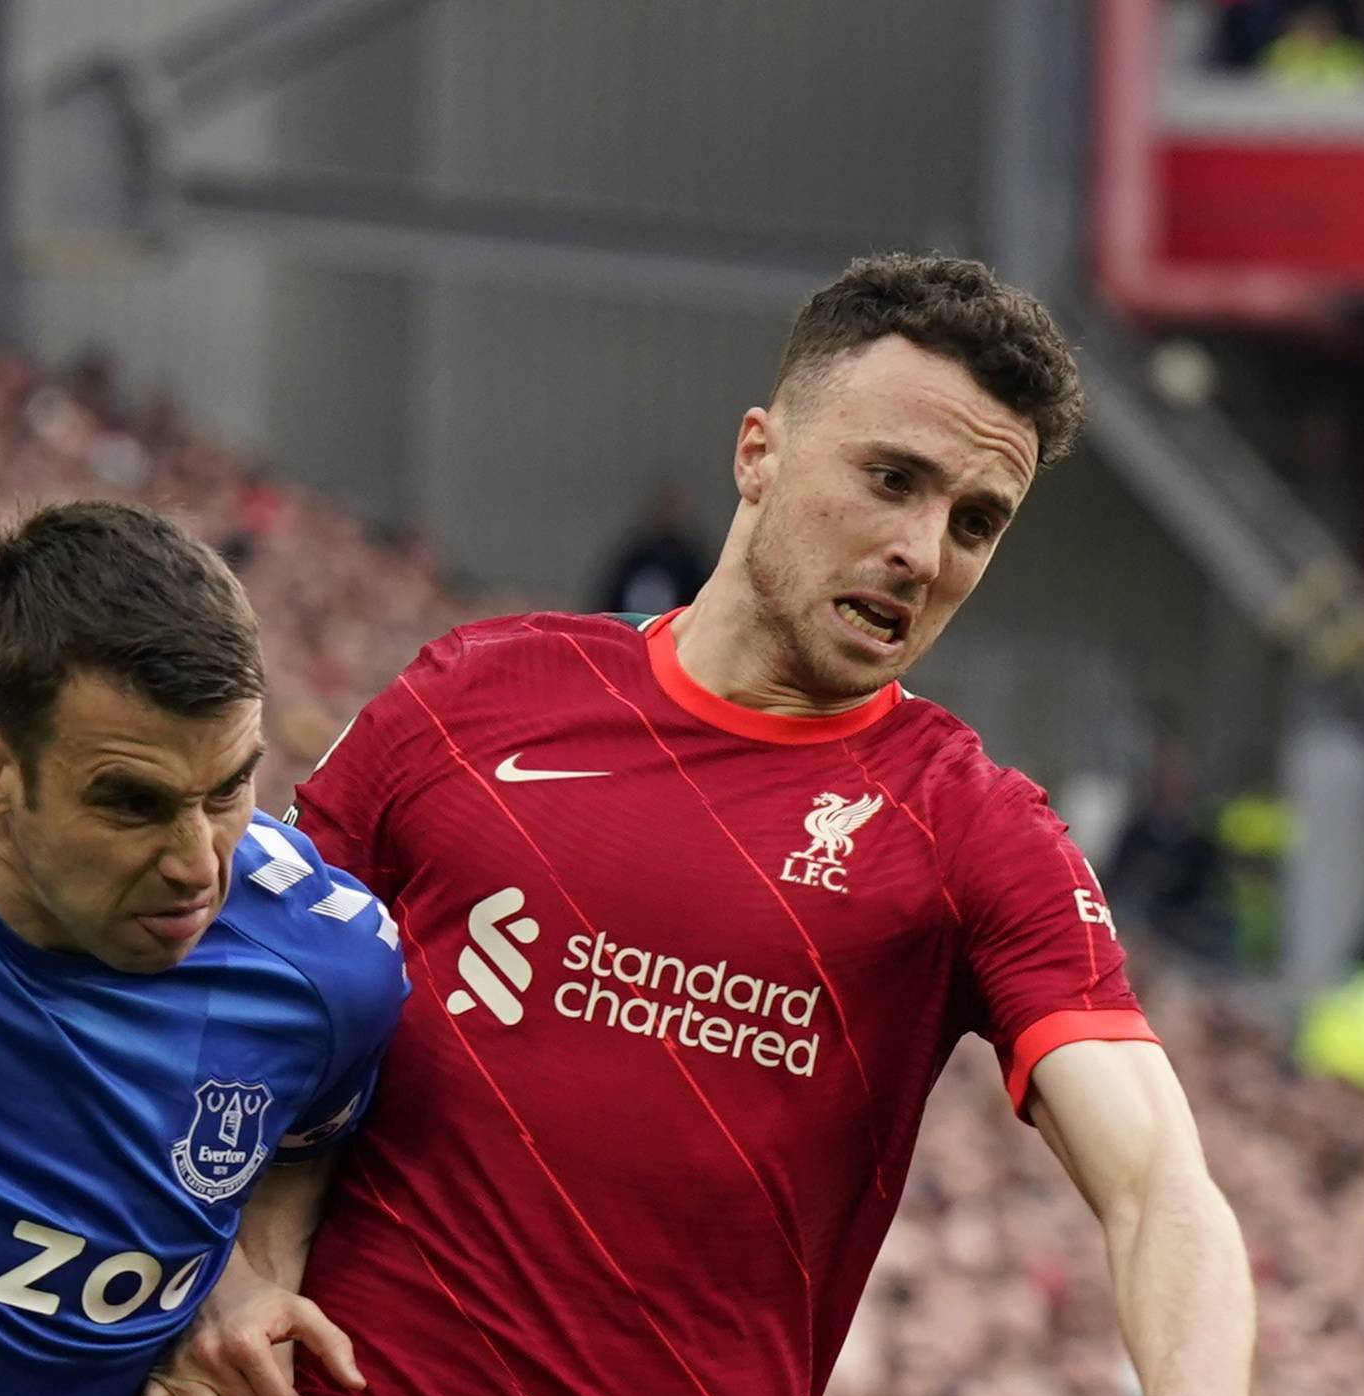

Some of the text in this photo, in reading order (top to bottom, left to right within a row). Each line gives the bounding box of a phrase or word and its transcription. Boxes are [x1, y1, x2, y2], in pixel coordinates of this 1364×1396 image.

[554, 978, 820, 1077] chartered
[562, 931, 821, 1028] standard
[198, 1145, 247, 1164] Everton
